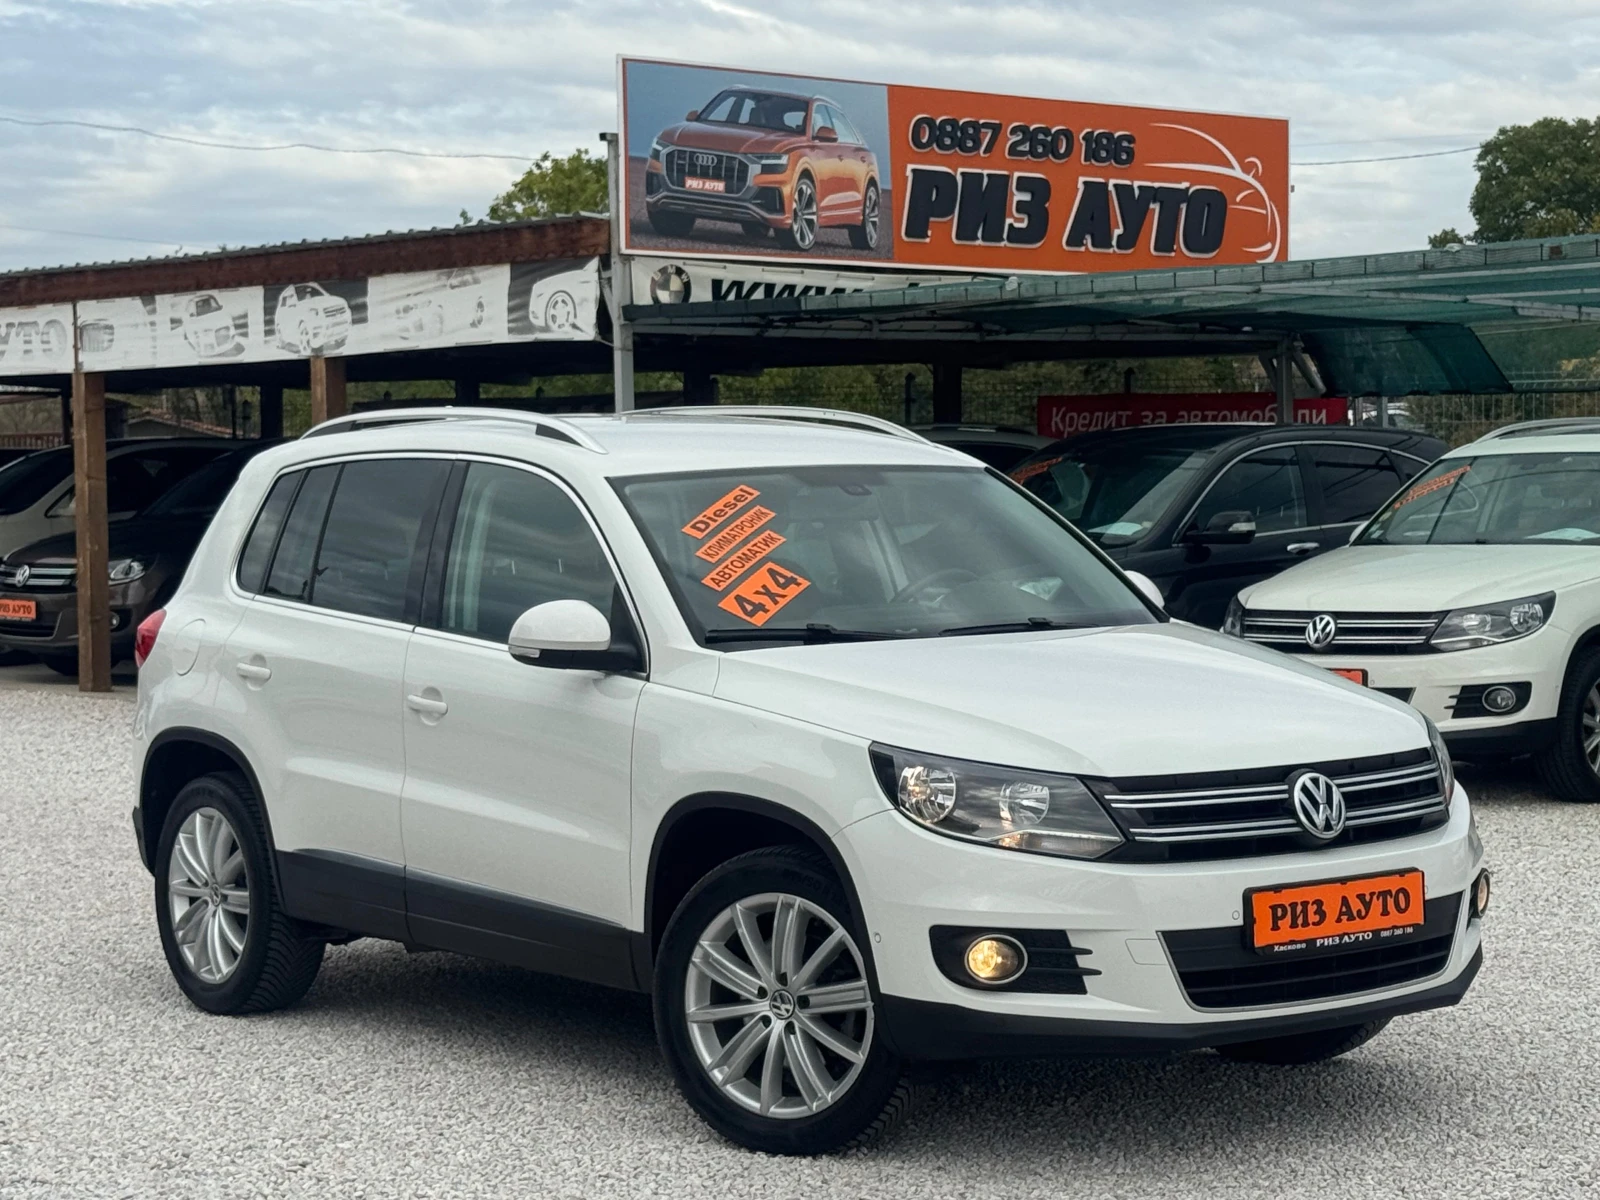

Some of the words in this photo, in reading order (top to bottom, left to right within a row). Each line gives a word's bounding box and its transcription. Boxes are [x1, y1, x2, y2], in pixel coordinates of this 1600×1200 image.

[910, 114, 1002, 157] 0887
[1005, 122, 1075, 162] 260
[1079, 128, 1136, 167] 186
[686, 179, 703, 189] РИЗ
[704, 181, 725, 191] АУТО
[902, 164, 1051, 247] РИЗ
[1062, 176, 1227, 258] АУТО
[1050, 406, 1131, 439] Кредит
[1141, 411, 1167, 425] за
[1177, 404, 1327, 425] автомобли
[690, 488, 754, 533] Diesel
[701, 508, 770, 559] КЛИМАТРОНИК
[710, 533, 780, 588] АВТОМАТИК
[1269, 899, 1327, 931] РИЗ
[1335, 887, 1411, 923] АУТО
[1274, 942, 1306, 952] Хасково
[1316, 937, 1340, 948] РИЗ
[1342, 932, 1373, 944] АУТО
